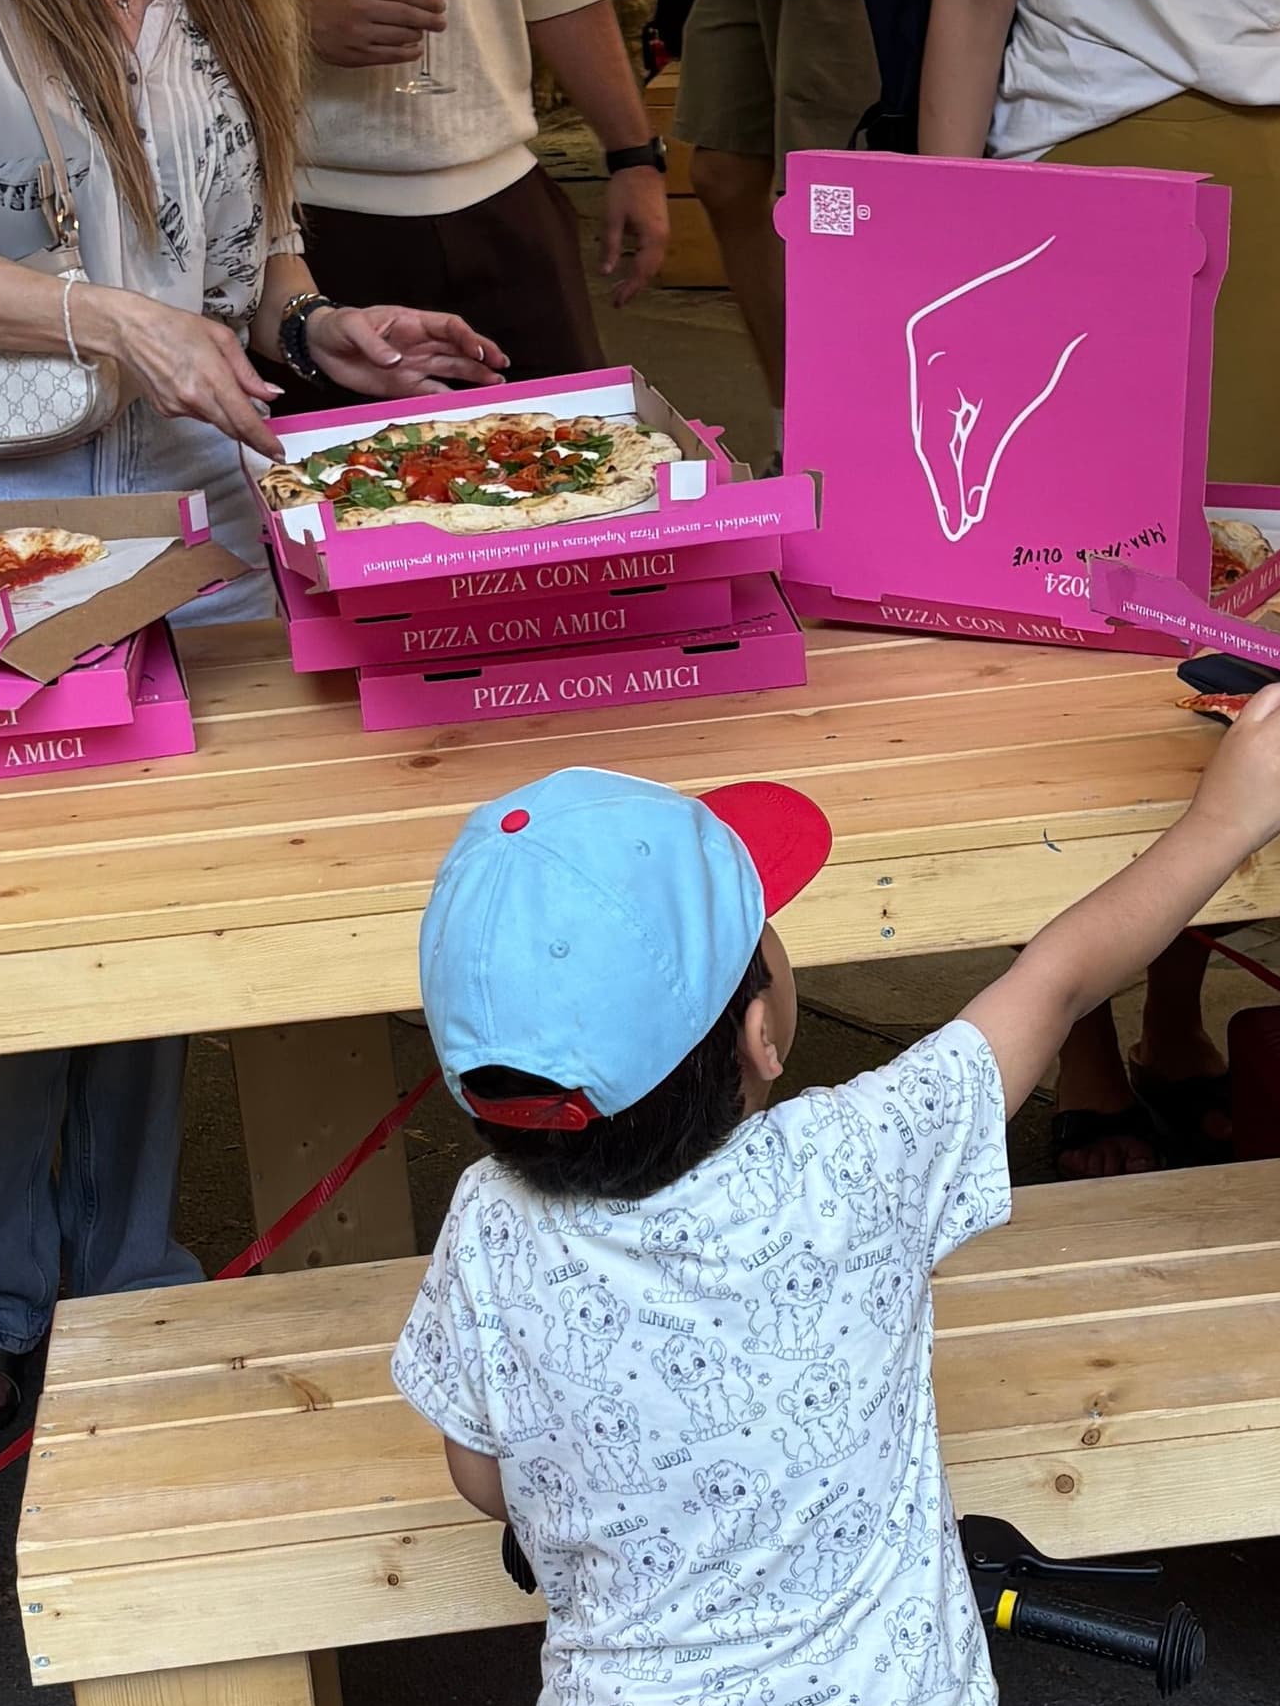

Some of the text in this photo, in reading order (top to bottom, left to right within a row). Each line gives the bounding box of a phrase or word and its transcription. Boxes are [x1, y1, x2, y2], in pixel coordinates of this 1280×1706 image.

[450, 553, 676, 599] PIZZA CON AMICI
[403, 624, 480, 653] PIZZA
[488, 617, 541, 644] CON
[552, 609, 627, 637] AMICI
[879, 604, 1086, 644] PIZZA CON AMICI
[473, 665, 701, 711] PIZZA CON AMICI
[4, 736, 87, 768] AMICI
[740, 1231, 793, 1272] HELLO
[845, 1245, 893, 1274] LITTLE
[543, 1259, 590, 1286] HELLO
[639, 1308, 697, 1333] LITTLE
[858, 1380, 891, 1422] LION
[651, 1447, 692, 1470] LION
[795, 1481, 850, 1525] HELLO
[600, 1514, 649, 1539] HELLO
[674, 1646, 713, 1665] LION
